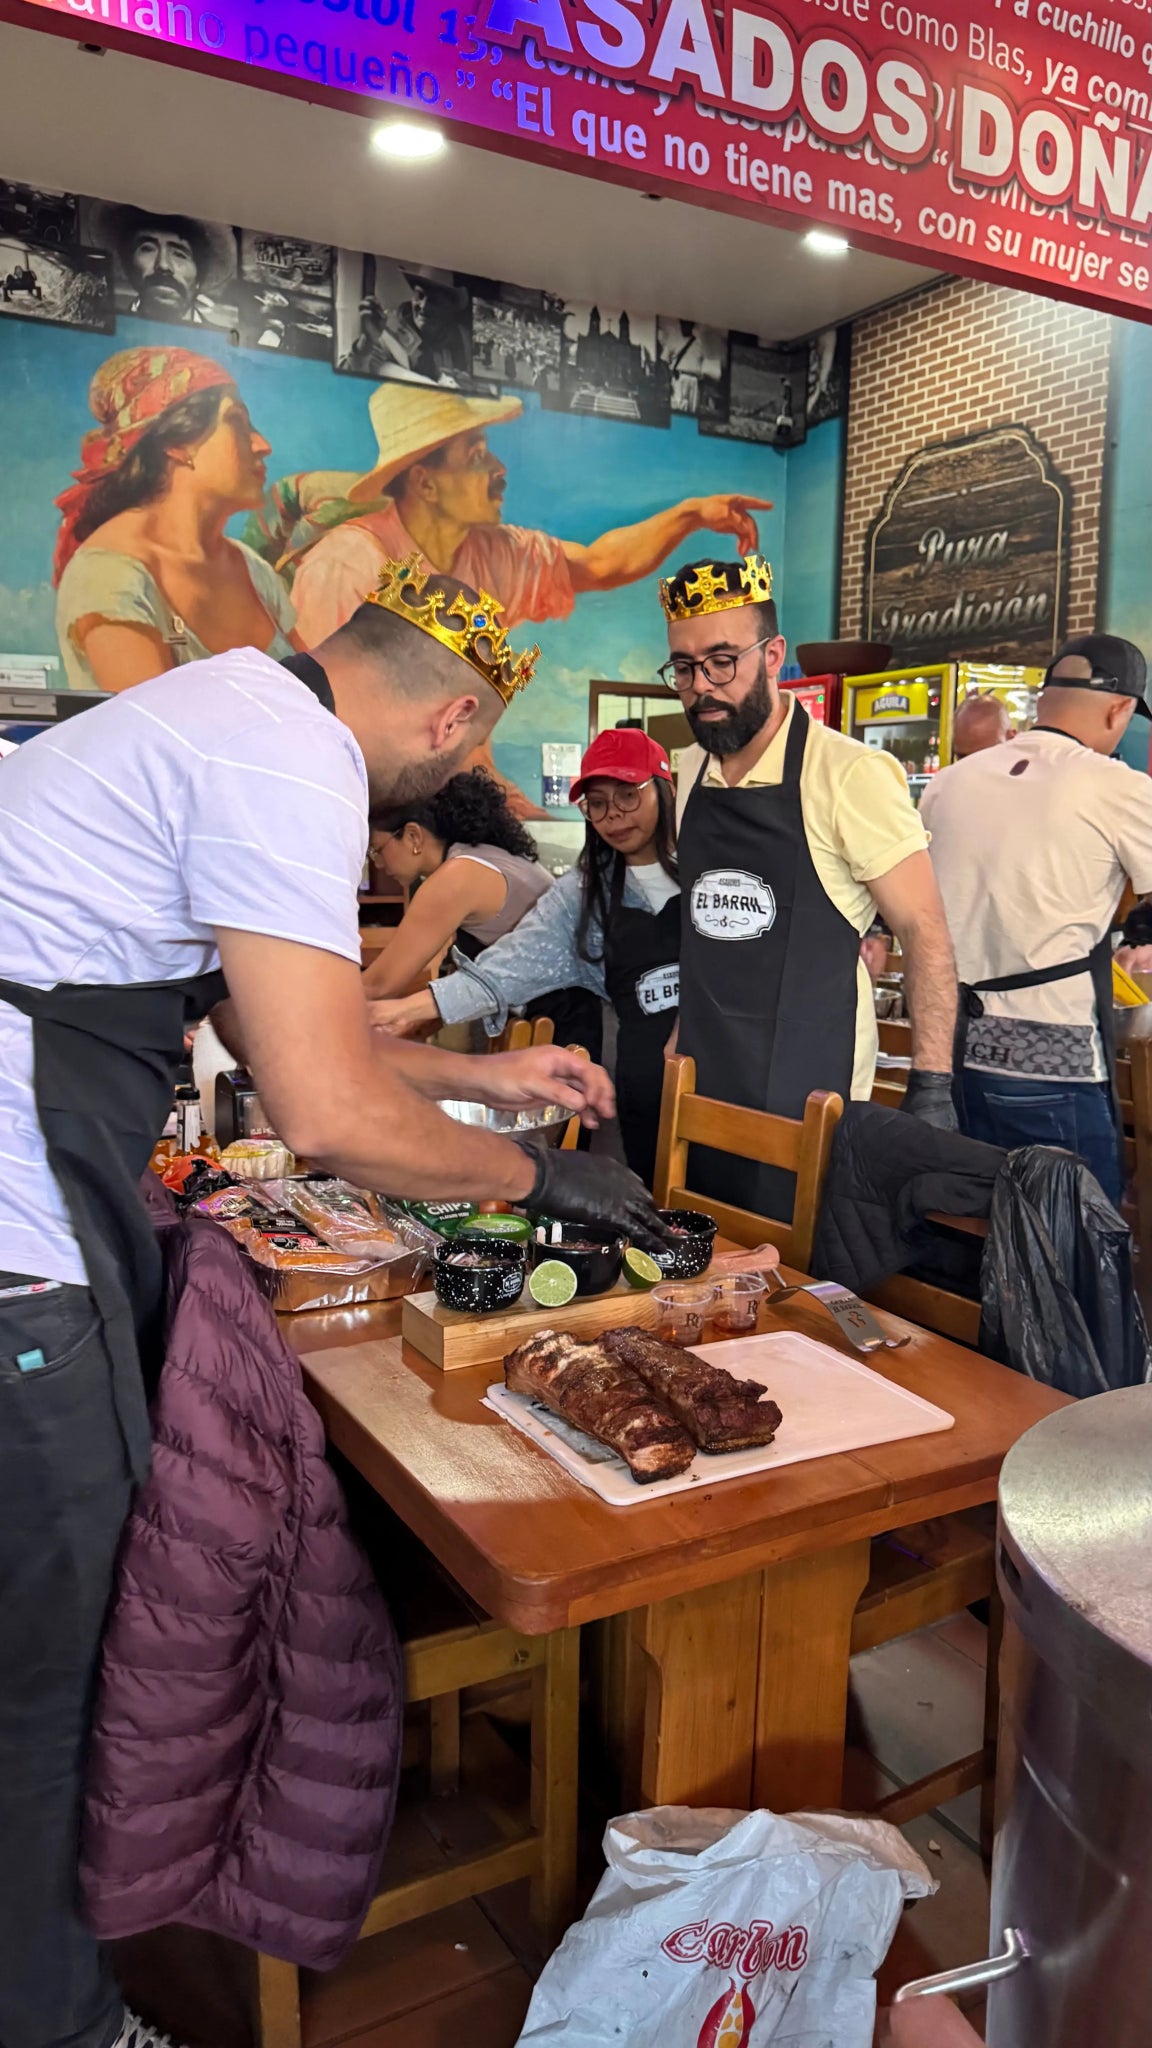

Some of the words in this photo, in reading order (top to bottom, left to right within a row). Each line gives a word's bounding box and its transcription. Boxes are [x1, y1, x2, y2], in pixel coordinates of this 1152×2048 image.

[880, 1, 958, 51] como
[968, 22, 1033, 86] Blas,
[1041, 57, 1079, 95] ya
[1037, 1, 1135, 58] cuchillo
[572, 108, 647, 159] que
[664, 133, 710, 175] no
[725, 142, 813, 203] tiene
[827, 178, 903, 234] mas,
[918, 206, 977, 246] con
[984, 223, 1022, 258] su
[1029, 235, 1113, 282] mujer
[1117, 259, 1150, 292] se
[918, 526, 1010, 575] Pura
[878, 580, 1050, 642] Tradición
[696, 892, 709, 910] EL
[712, 893, 767, 915] BARRIL
[644, 988, 659, 1004] EL
